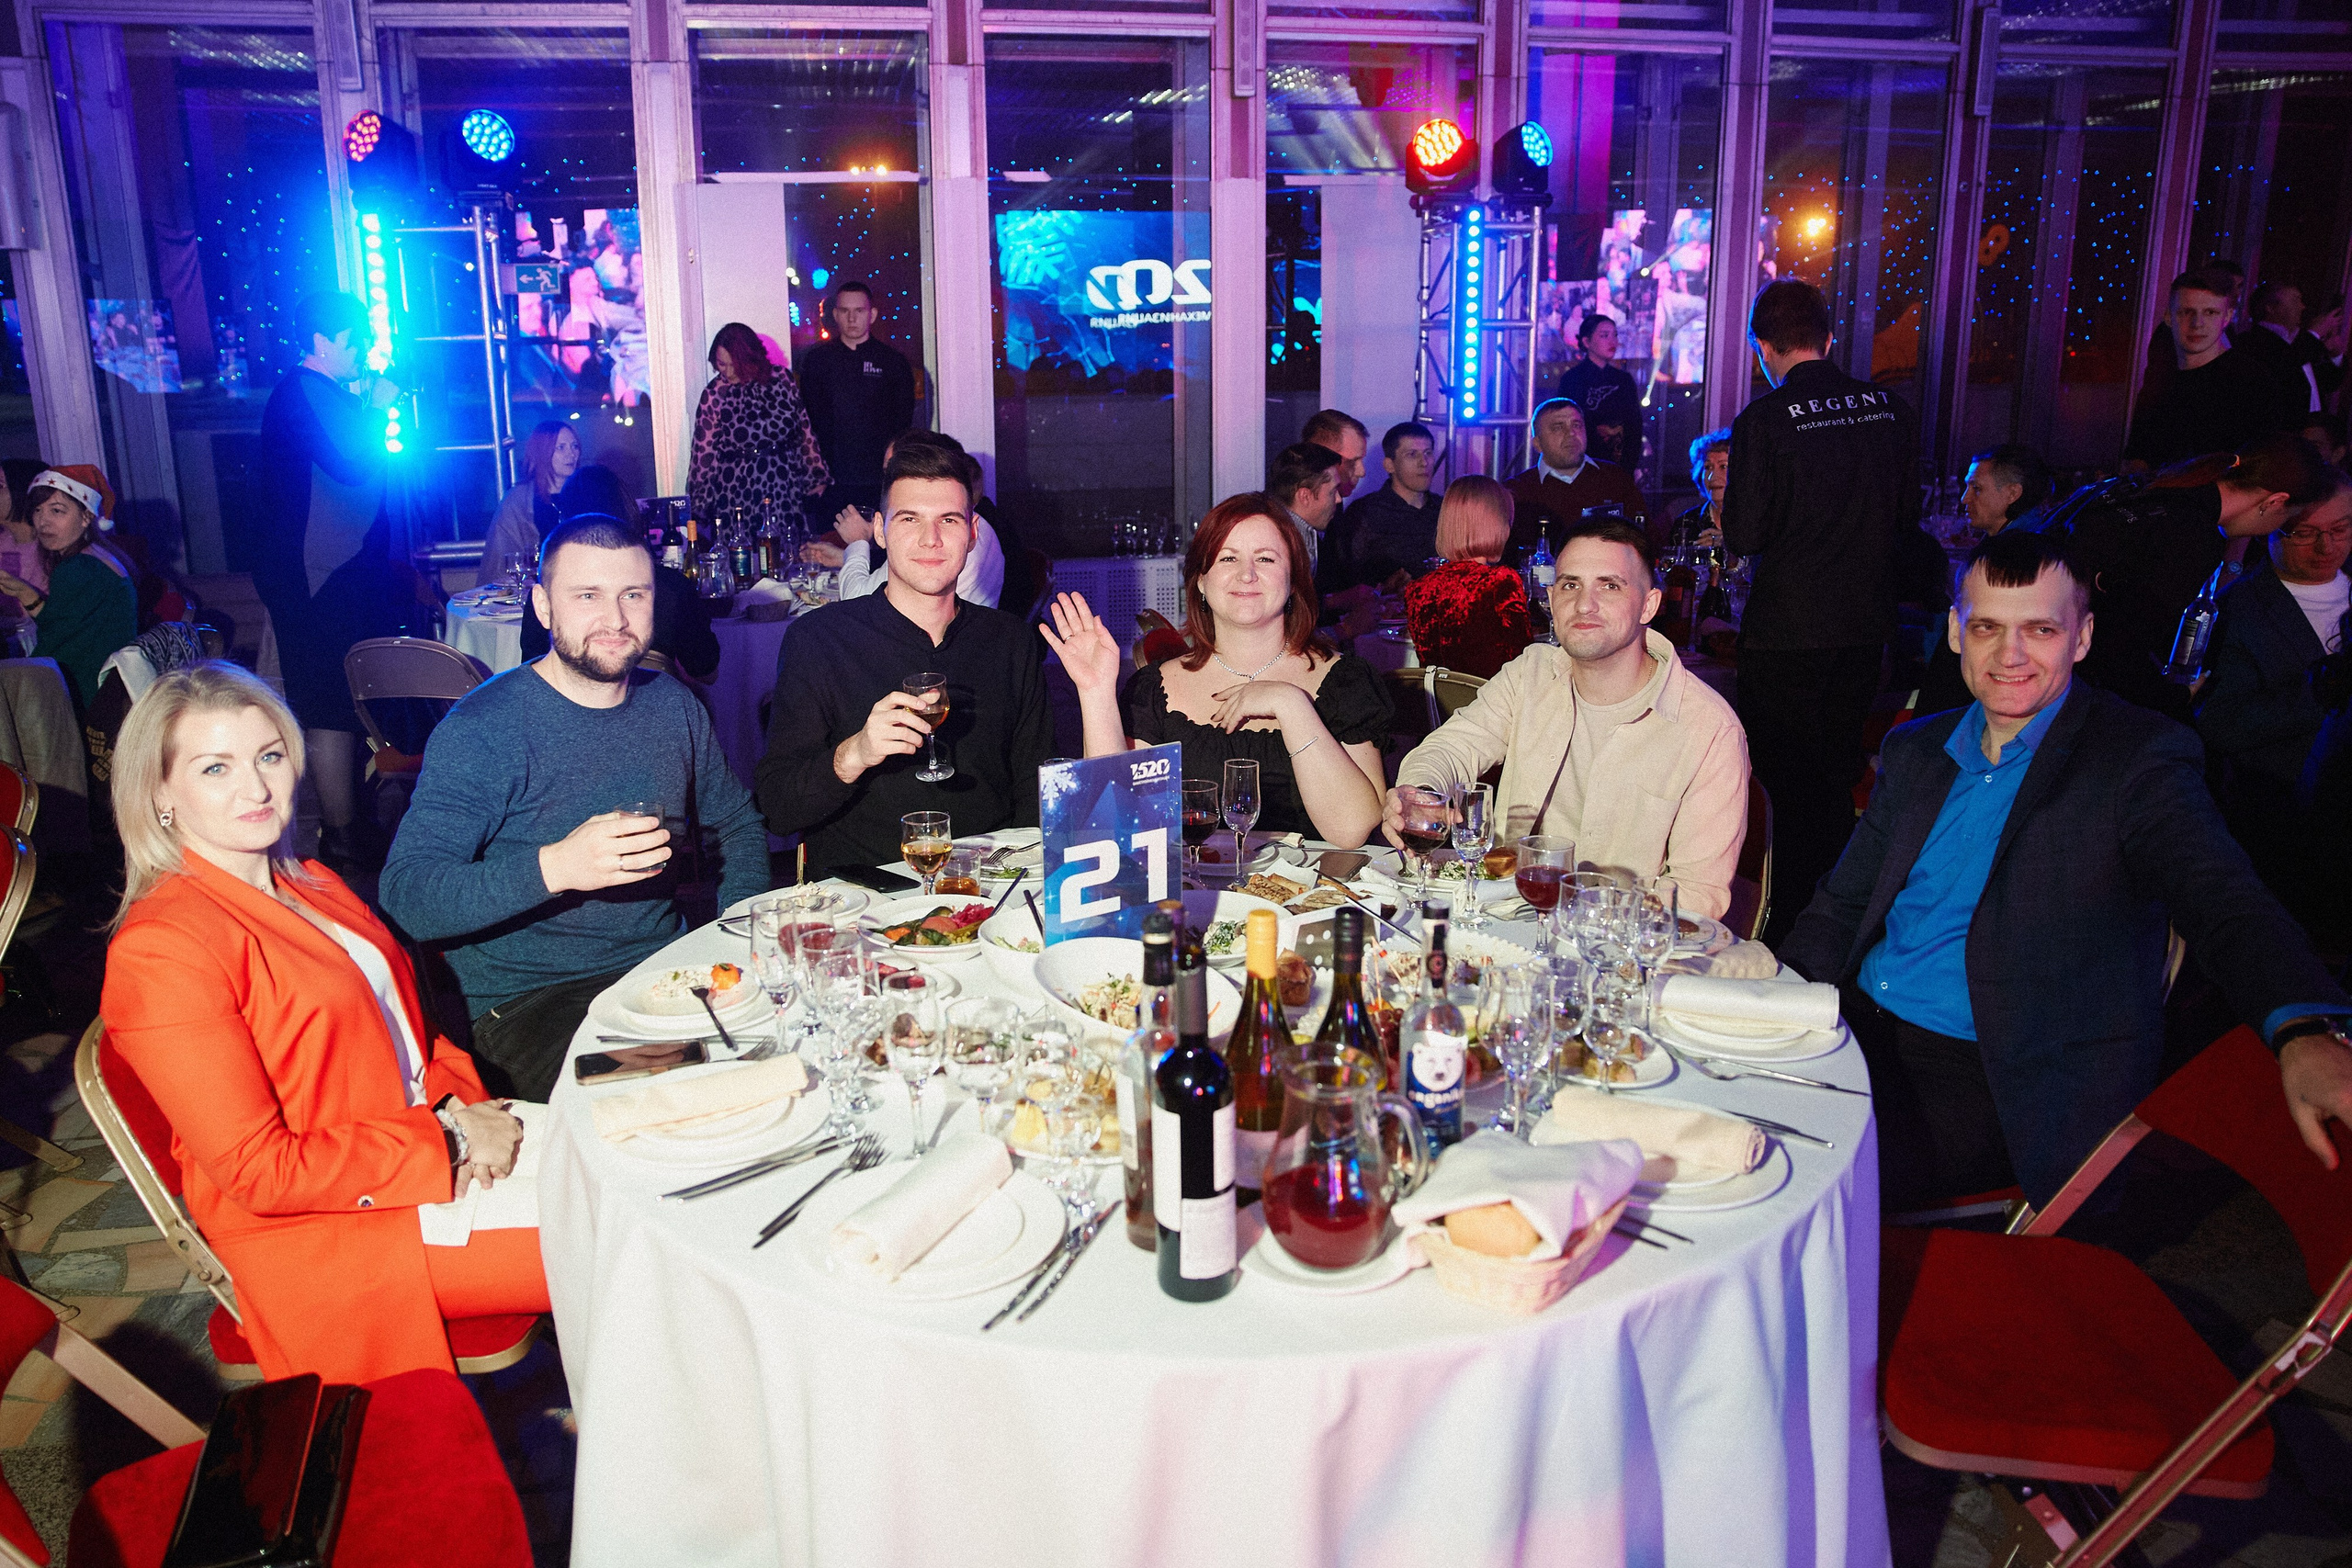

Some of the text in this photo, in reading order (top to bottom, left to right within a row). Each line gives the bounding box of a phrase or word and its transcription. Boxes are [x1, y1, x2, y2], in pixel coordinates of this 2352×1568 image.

[1788, 391, 1888, 418] REGENT
[1796, 411, 1895, 432] restaurant & catering
[1130, 758, 1170, 781] 1520
[1059, 827, 1168, 924] 21
